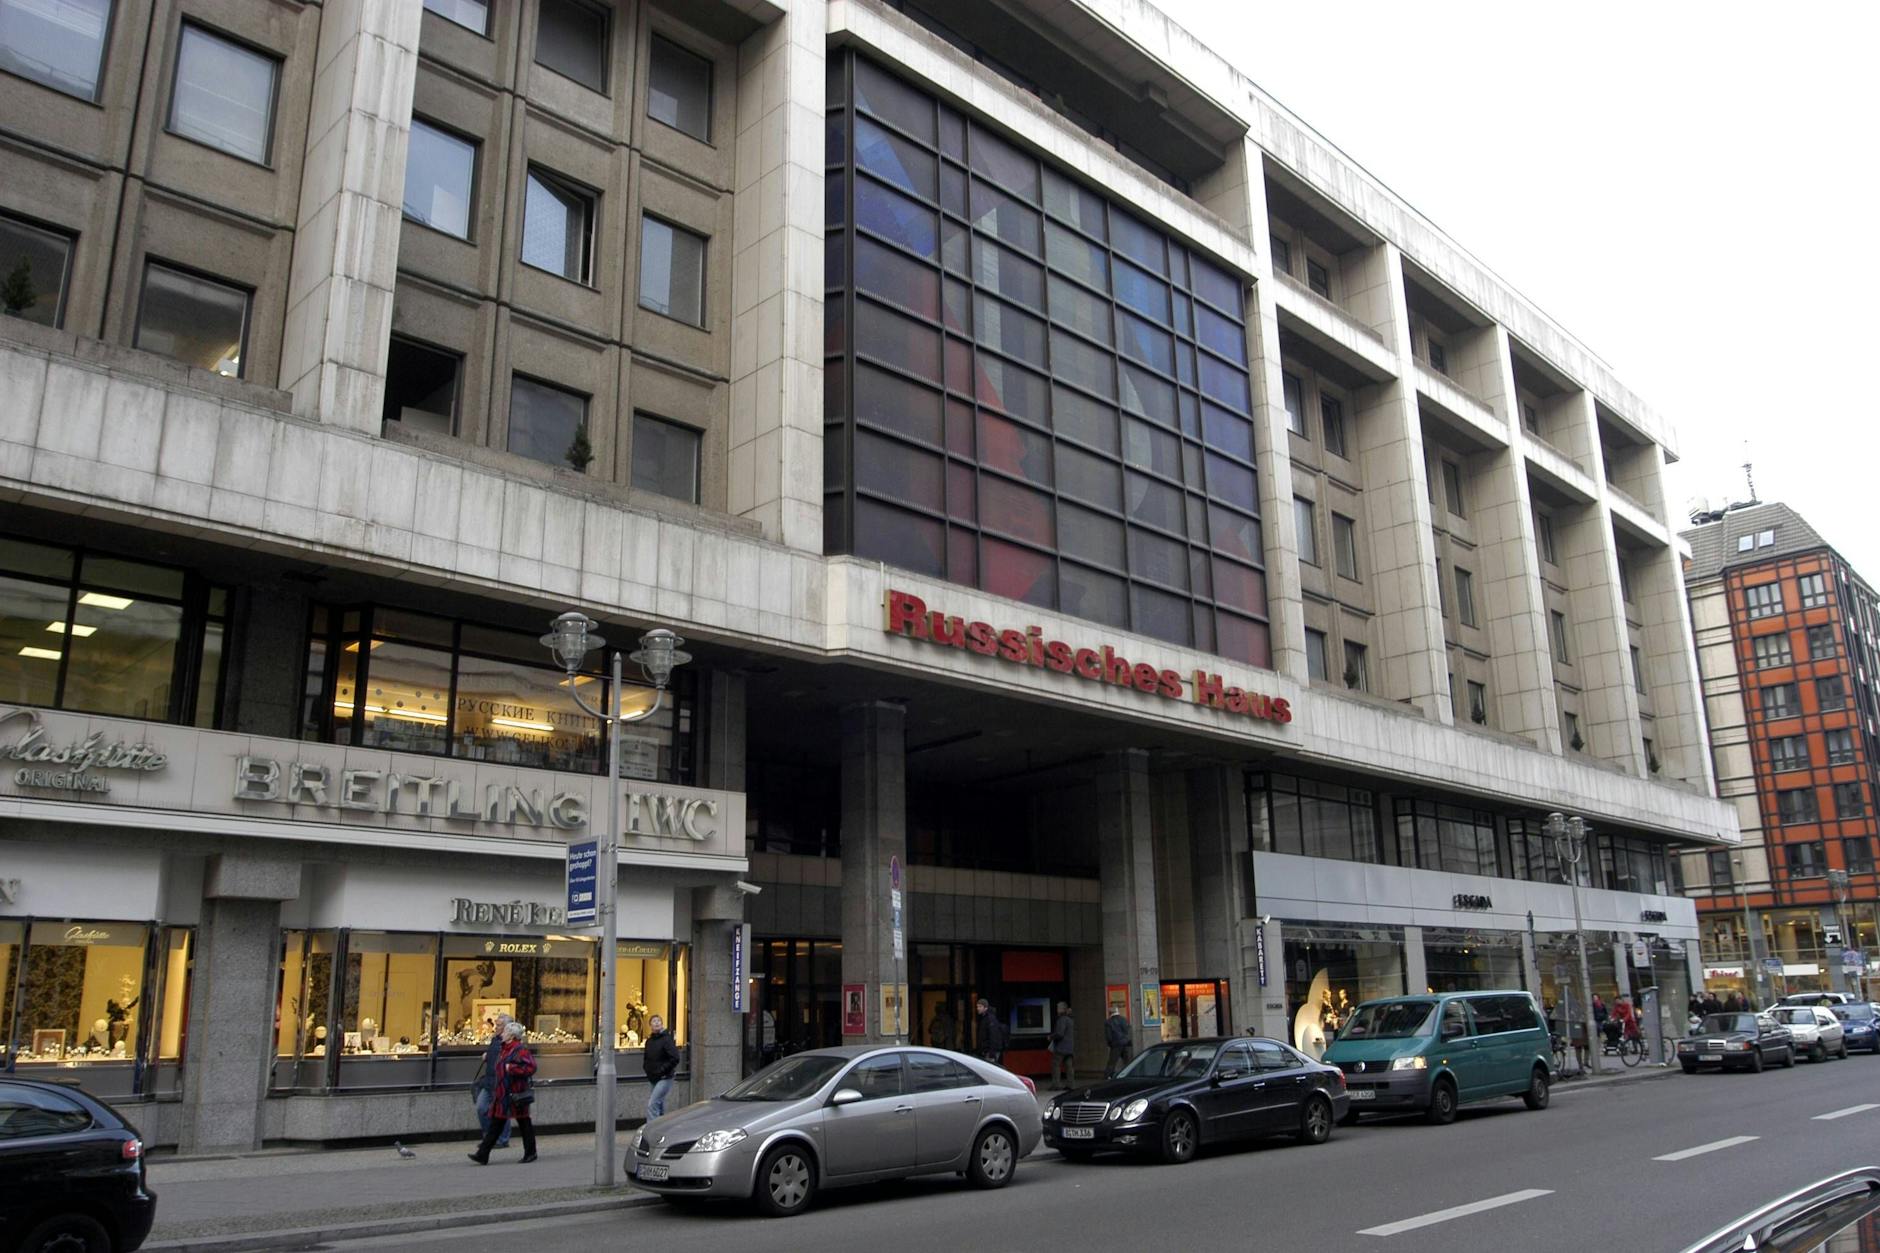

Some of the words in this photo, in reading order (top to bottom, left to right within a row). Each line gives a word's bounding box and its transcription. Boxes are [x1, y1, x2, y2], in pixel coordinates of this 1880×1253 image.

[883, 588, 1182, 699] Russisches
[1191, 669, 1293, 724] Haus
[457, 696, 534, 721] РУССКИЕ
[14, 767, 112, 793] ORIGINAL
[233, 755, 589, 830] BREITLING
[626, 791, 718, 841] IWC
[498, 943, 538, 954] ROLEX
[1256, 927, 1265, 985] KABARETT
